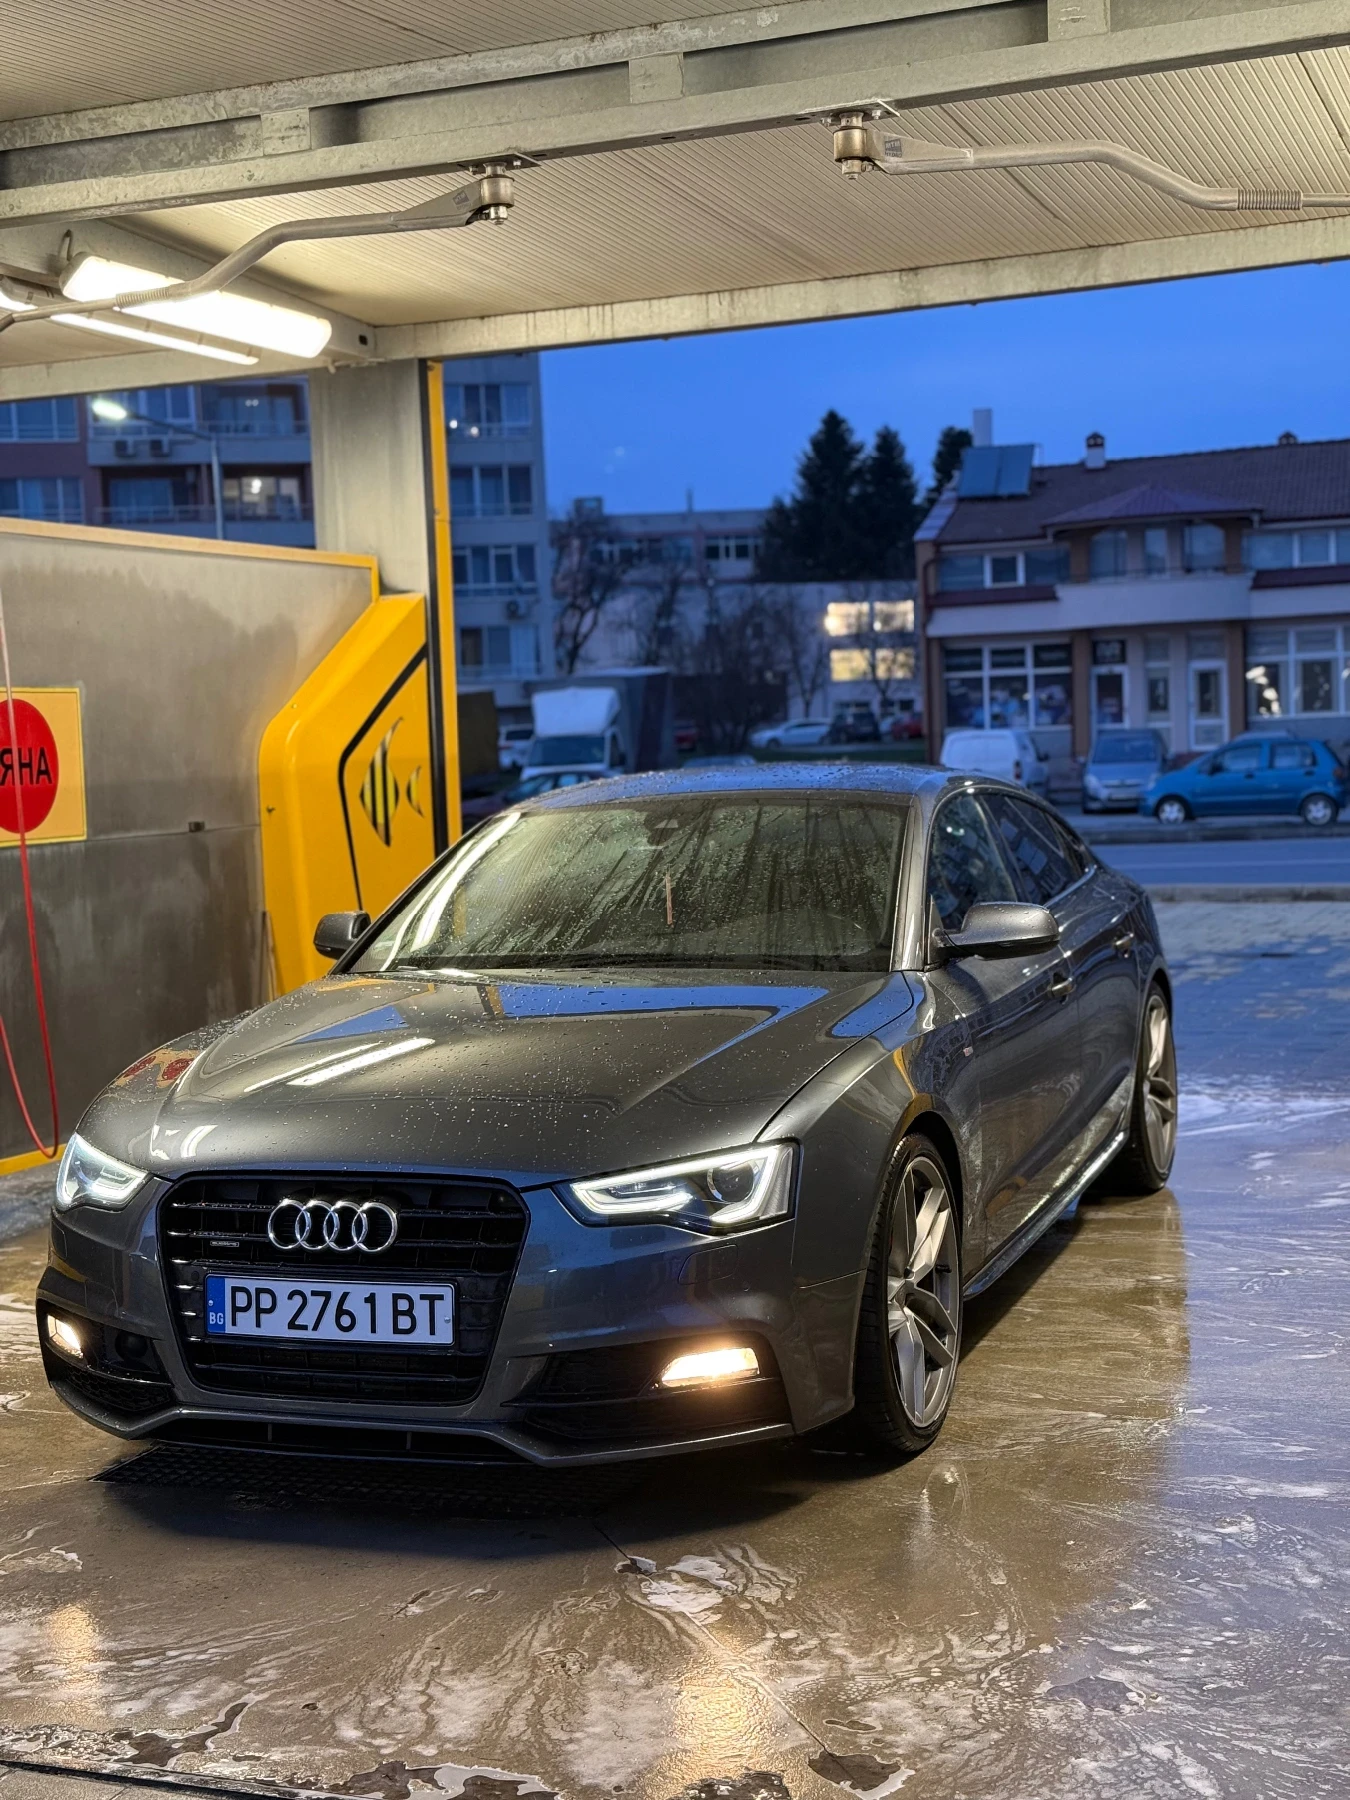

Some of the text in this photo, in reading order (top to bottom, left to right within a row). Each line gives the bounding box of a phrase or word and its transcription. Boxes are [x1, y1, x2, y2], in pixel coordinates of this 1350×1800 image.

[0, 746, 52, 786] ЯНА
[209, 1312, 224, 1325] BG
[230, 1285, 445, 1336] PP 2761 BT
